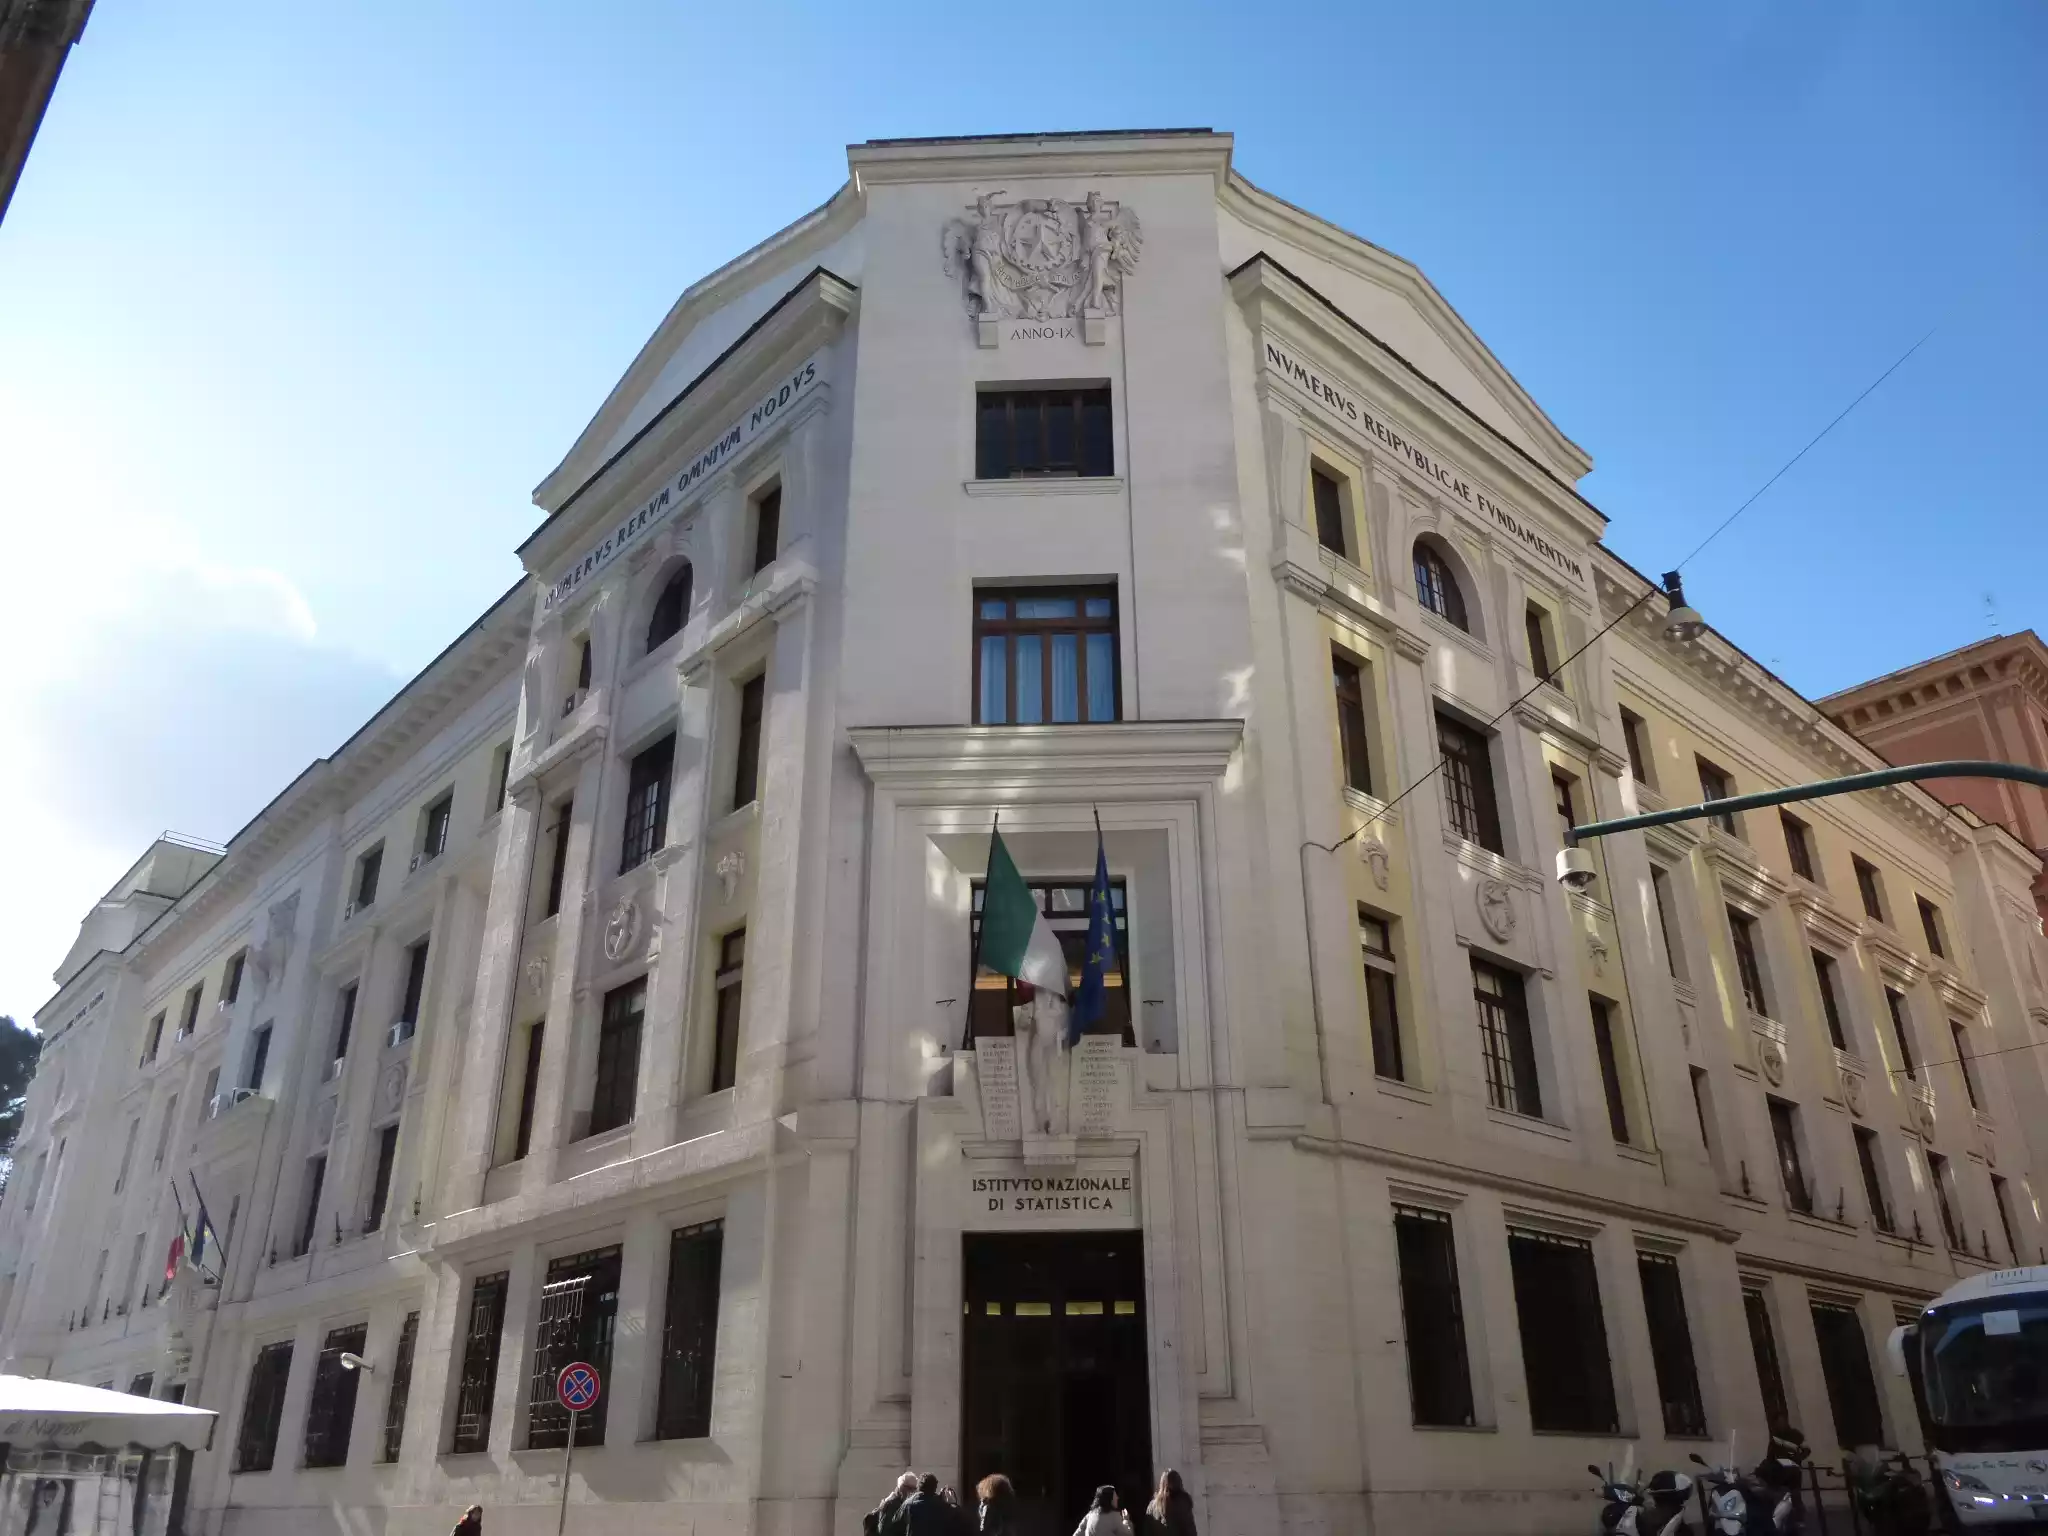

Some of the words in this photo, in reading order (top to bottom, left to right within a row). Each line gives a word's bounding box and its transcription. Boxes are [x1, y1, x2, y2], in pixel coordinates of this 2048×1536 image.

[616, 488, 670, 547] RERVM
[678, 426, 741, 491] OMNIVM
[750, 363, 816, 432] NODVS
[1267, 343, 1358, 420] NVMERVS
[1363, 411, 1473, 504] REIPVBLICAE
[1477, 493, 1585, 583] FVNDAMENTVM
[972, 1178, 1044, 1192] ISTITVTO
[1046, 1178, 1132, 1191] NAZIONALE
[988, 1197, 1004, 1211] DI
[1014, 1196, 1114, 1211] STATISTICA
